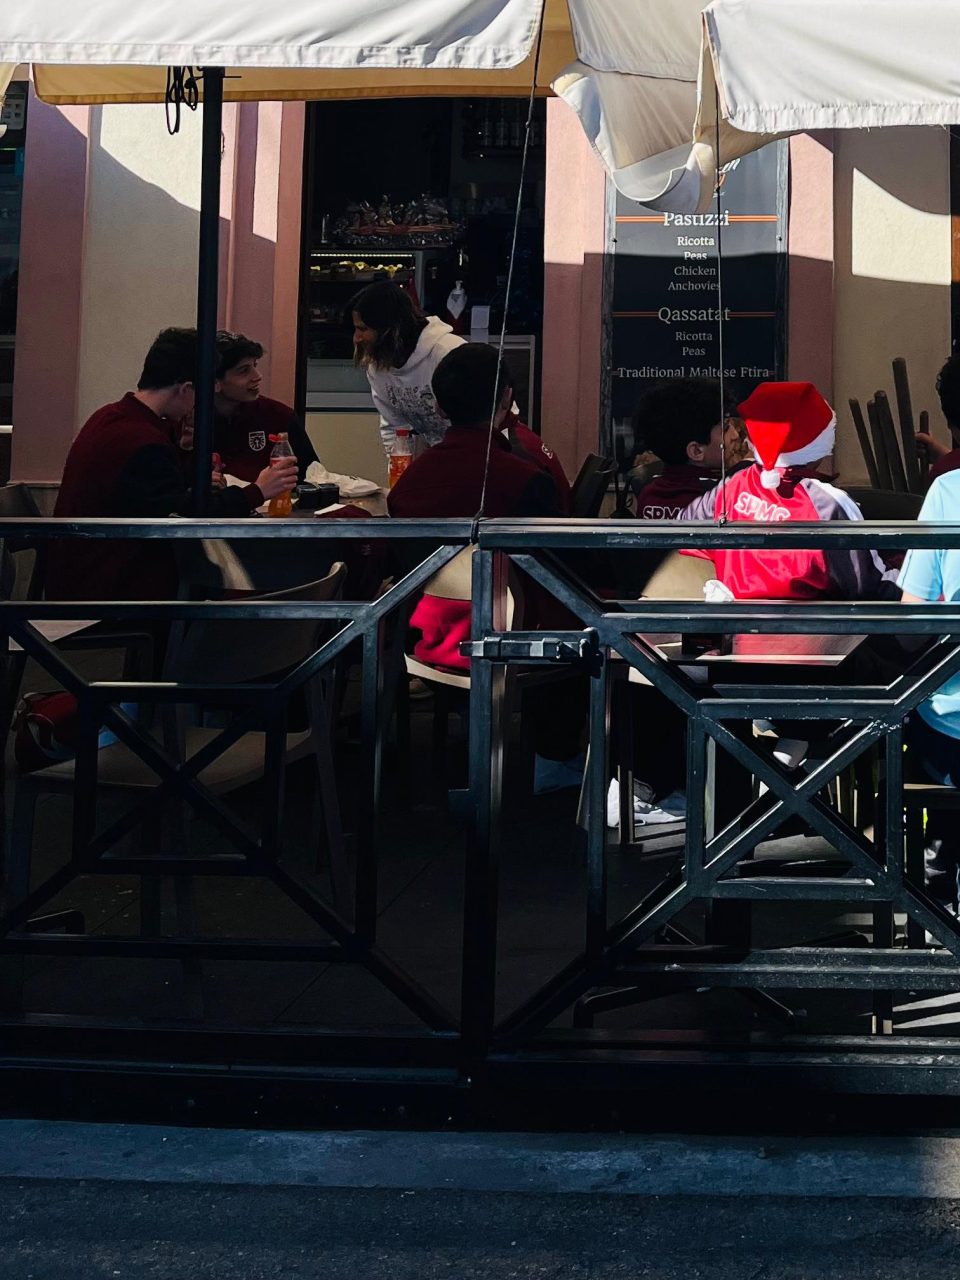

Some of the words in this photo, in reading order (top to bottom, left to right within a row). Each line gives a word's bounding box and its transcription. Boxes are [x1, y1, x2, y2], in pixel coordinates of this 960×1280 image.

[663, 210, 730, 227] Pastizzi
[677, 236, 715, 246] Ricotta
[684, 251, 708, 261] Peas
[674, 266, 716, 276] Chicken
[668, 281, 720, 291] Anchovies
[658, 307, 731, 324] Qassatat
[675, 331, 713, 341] Ricotta
[682, 346, 706, 356] Peas
[617, 366, 685, 378] Traditional
[690, 366, 736, 378] Maltese
[741, 366, 769, 378] Ftira
